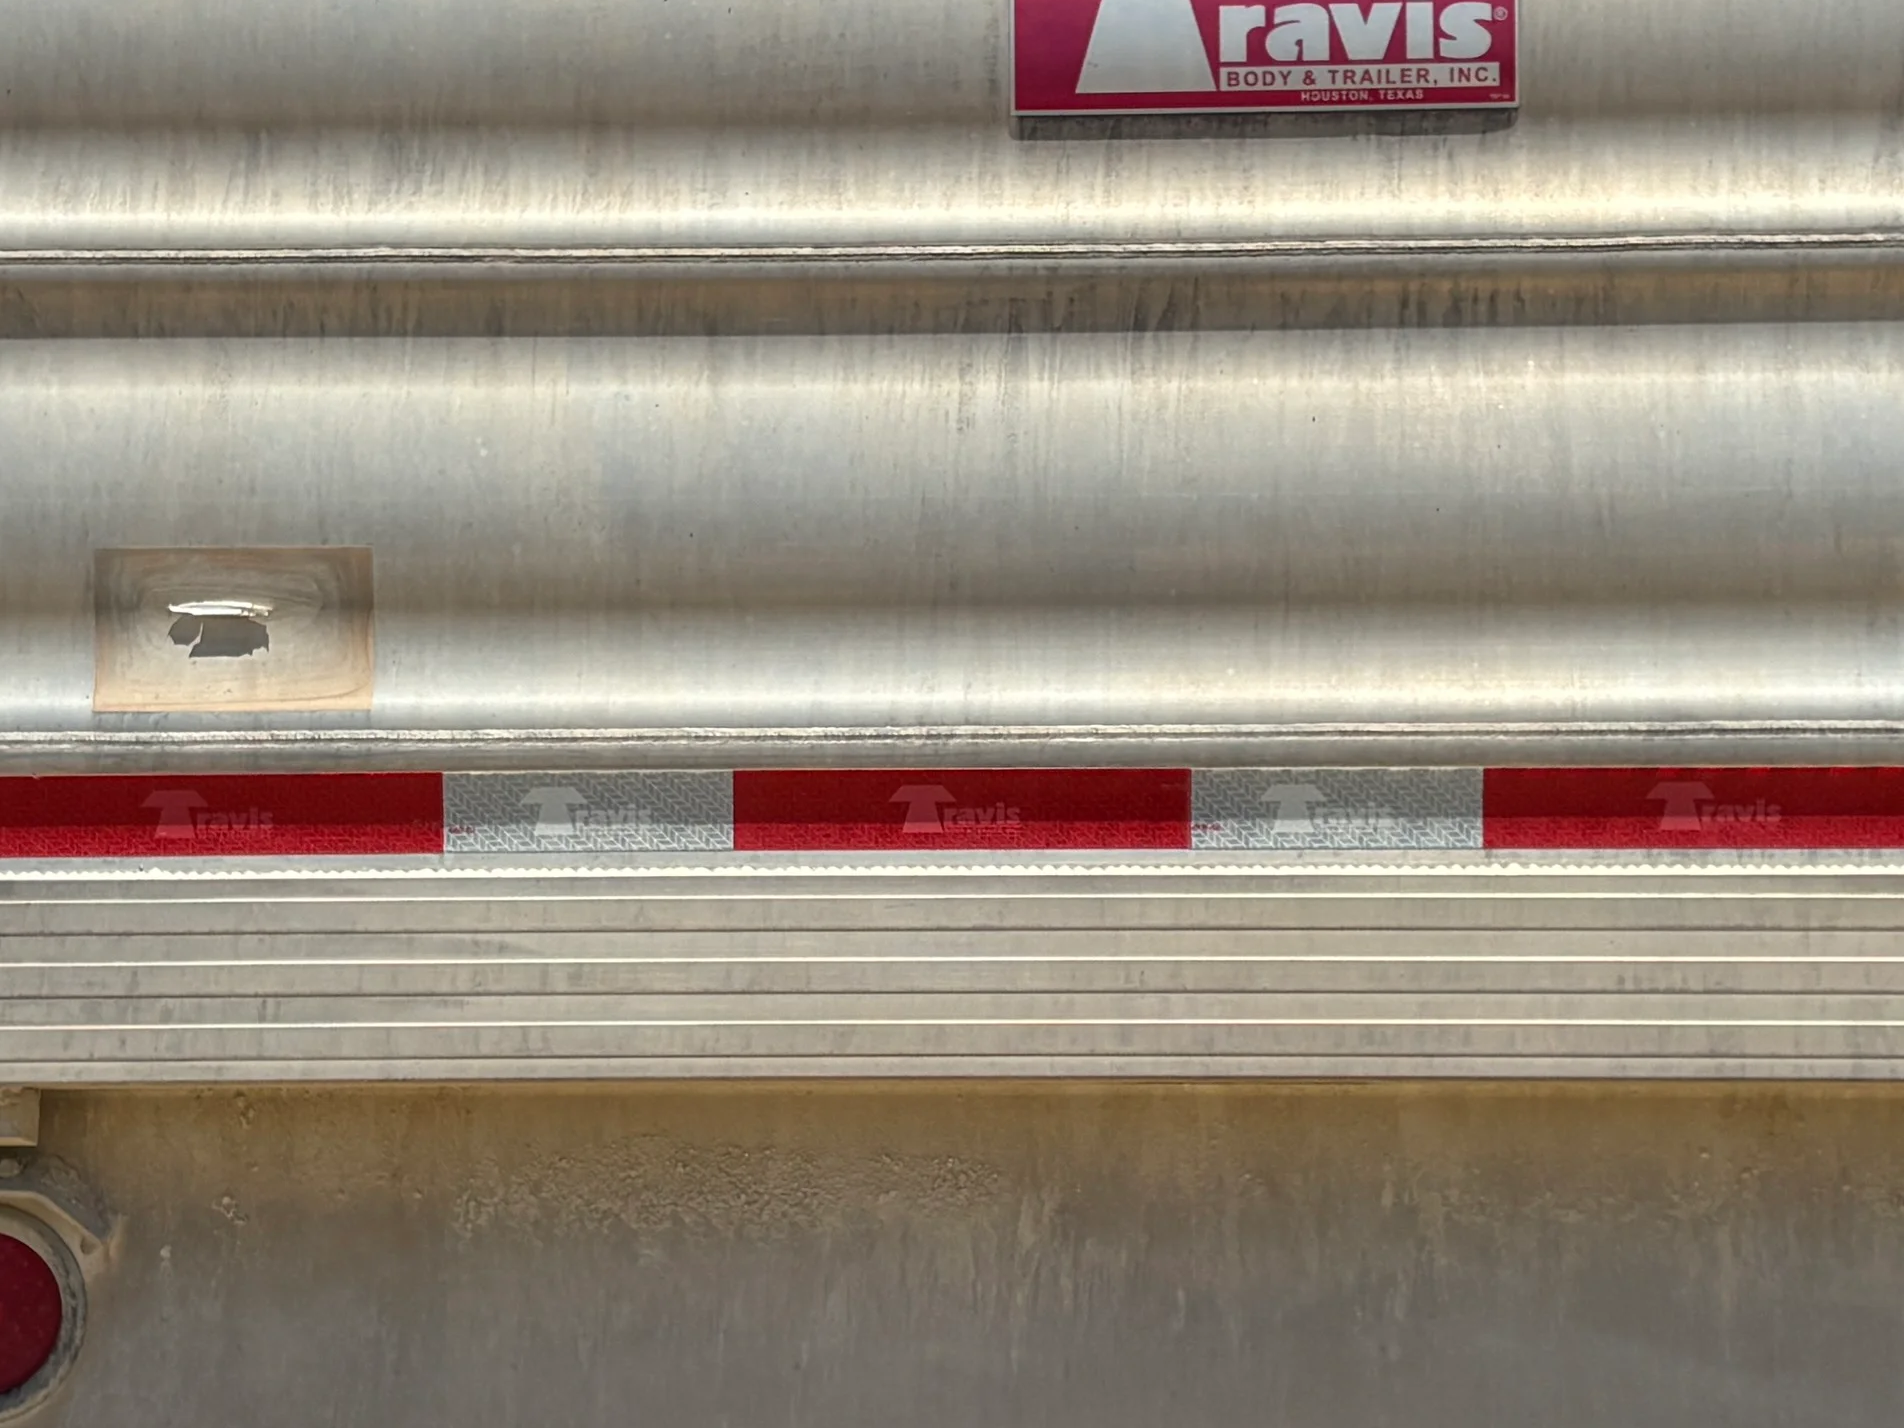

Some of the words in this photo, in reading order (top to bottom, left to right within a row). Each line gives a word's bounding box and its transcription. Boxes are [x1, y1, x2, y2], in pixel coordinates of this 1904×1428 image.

[1226, 68, 1293, 88] BODY
[1301, 69, 1317, 87] &
[1327, 66, 1438, 87] TRAILER,
[1448, 65, 1497, 84] INC.
[1378, 88, 1424, 101] TEXAS
[888, 783, 1021, 834] Travis
[1646, 780, 1782, 831] Travis
